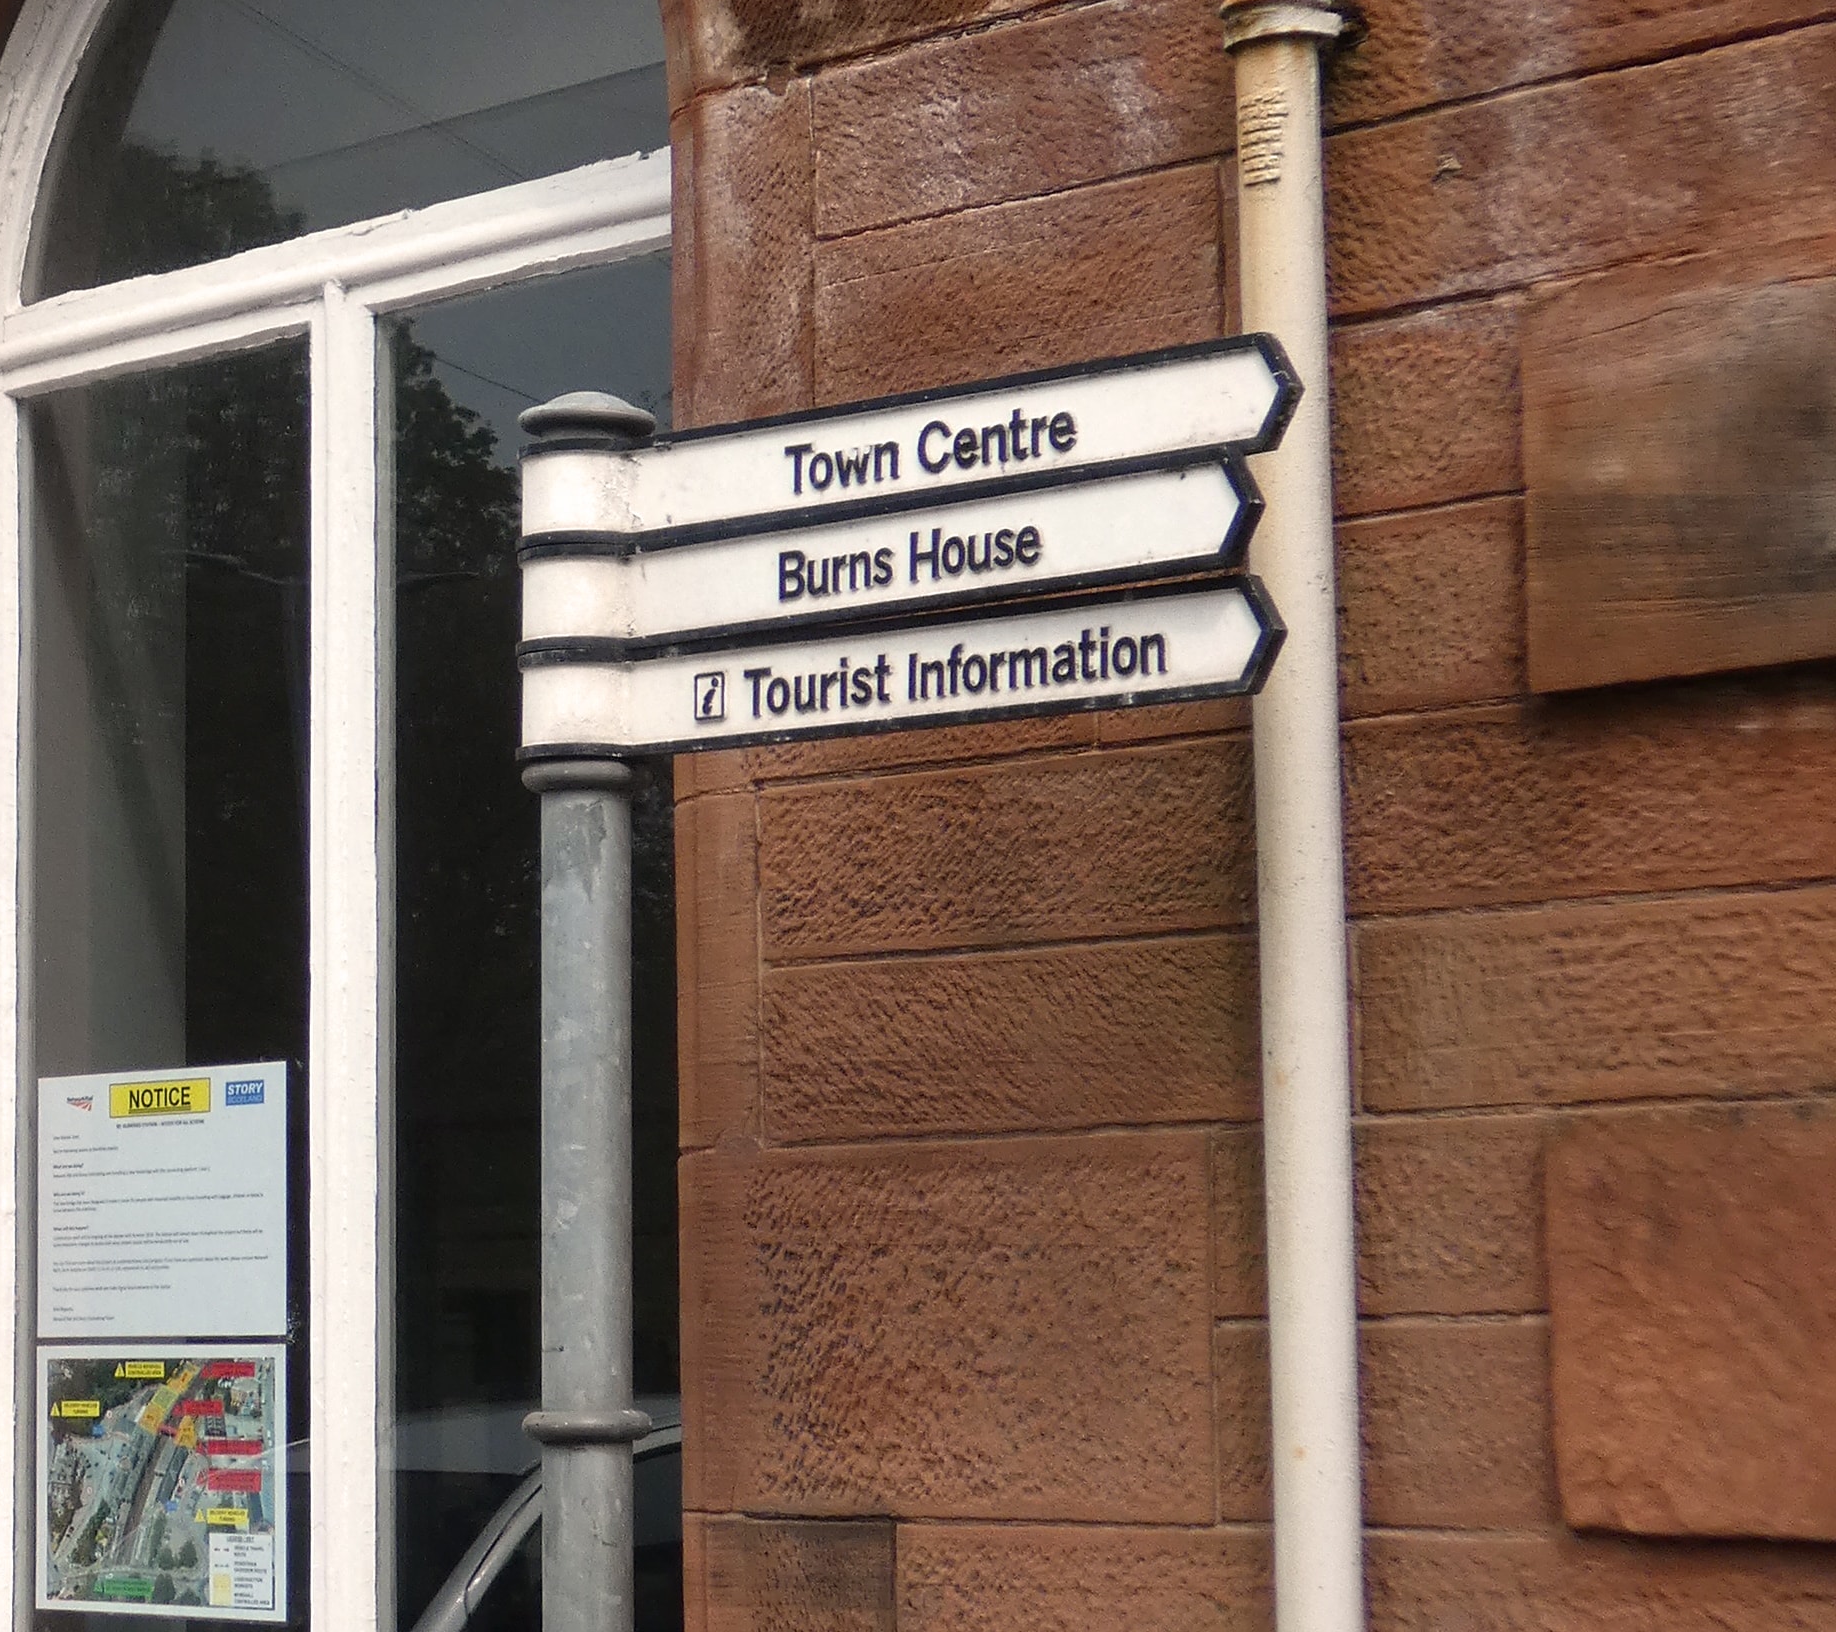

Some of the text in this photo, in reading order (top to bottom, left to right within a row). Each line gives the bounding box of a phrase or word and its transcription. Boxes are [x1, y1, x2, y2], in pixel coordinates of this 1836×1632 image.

[784, 406, 1079, 495] Town Centre
[777, 523, 1042, 603] Burns House
[743, 651, 892, 720] Tourist
[908, 625, 1168, 701] Information
[128, 1086, 192, 1109] NOTICE
[227, 1082, 263, 1096] STORY
